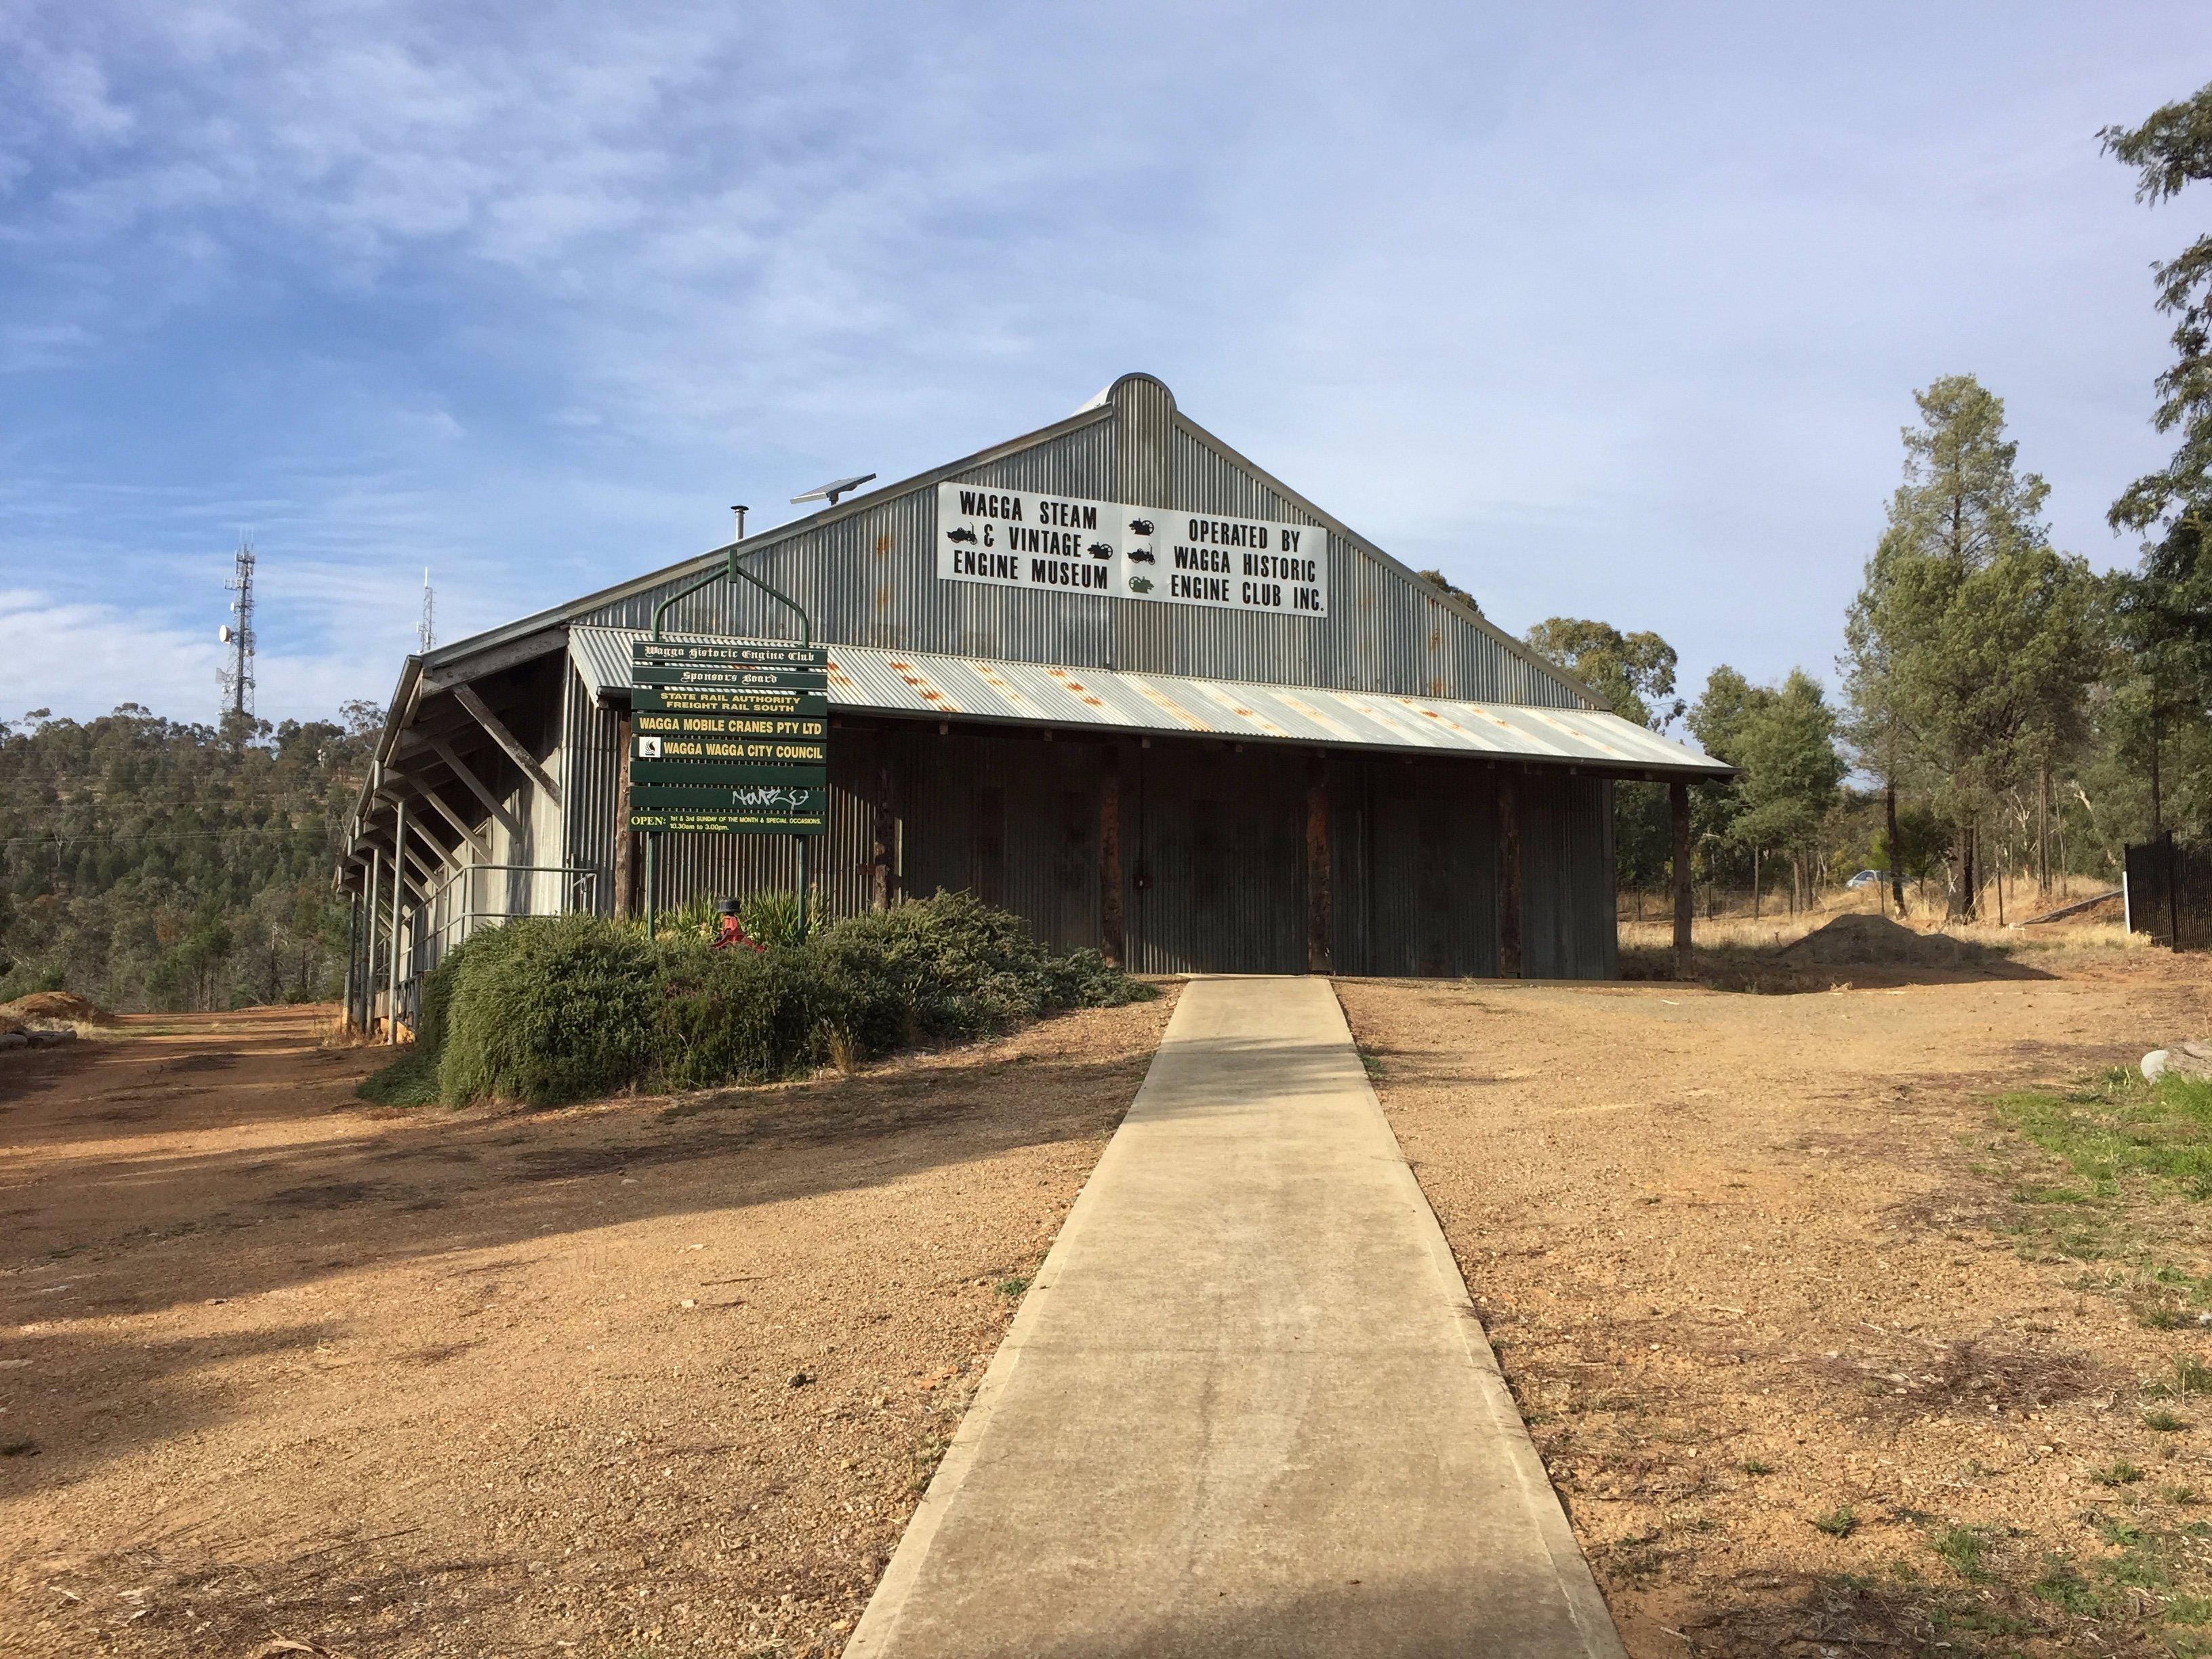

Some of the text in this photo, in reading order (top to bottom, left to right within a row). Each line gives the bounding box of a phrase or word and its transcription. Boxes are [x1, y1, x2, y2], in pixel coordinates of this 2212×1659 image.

[960, 490, 1097, 530] WAGGA STEAM
[983, 524, 1082, 558] & VINTAGE
[1189, 519, 1300, 552] OPERATED BY
[954, 550, 1108, 590] ENGINE MUSEUM
[1174, 546, 1315, 583] WAGGA HISTORIC
[1171, 575, 1324, 611] ENGINE CLUB INC.
[644, 646, 814, 661] Wagga Historic Engine Club
[680, 672, 778, 684] Sponsors Board
[666, 701, 718, 709] FREIGHT
[732, 695, 800, 703] AUTHORITY
[640, 717, 821, 735] WAGGA MOBILE CRANES PTY LTD
[664, 742, 823, 759] WAGGA WAGGA CITY COUNCIL
[631, 817, 666, 825] OPEN:
